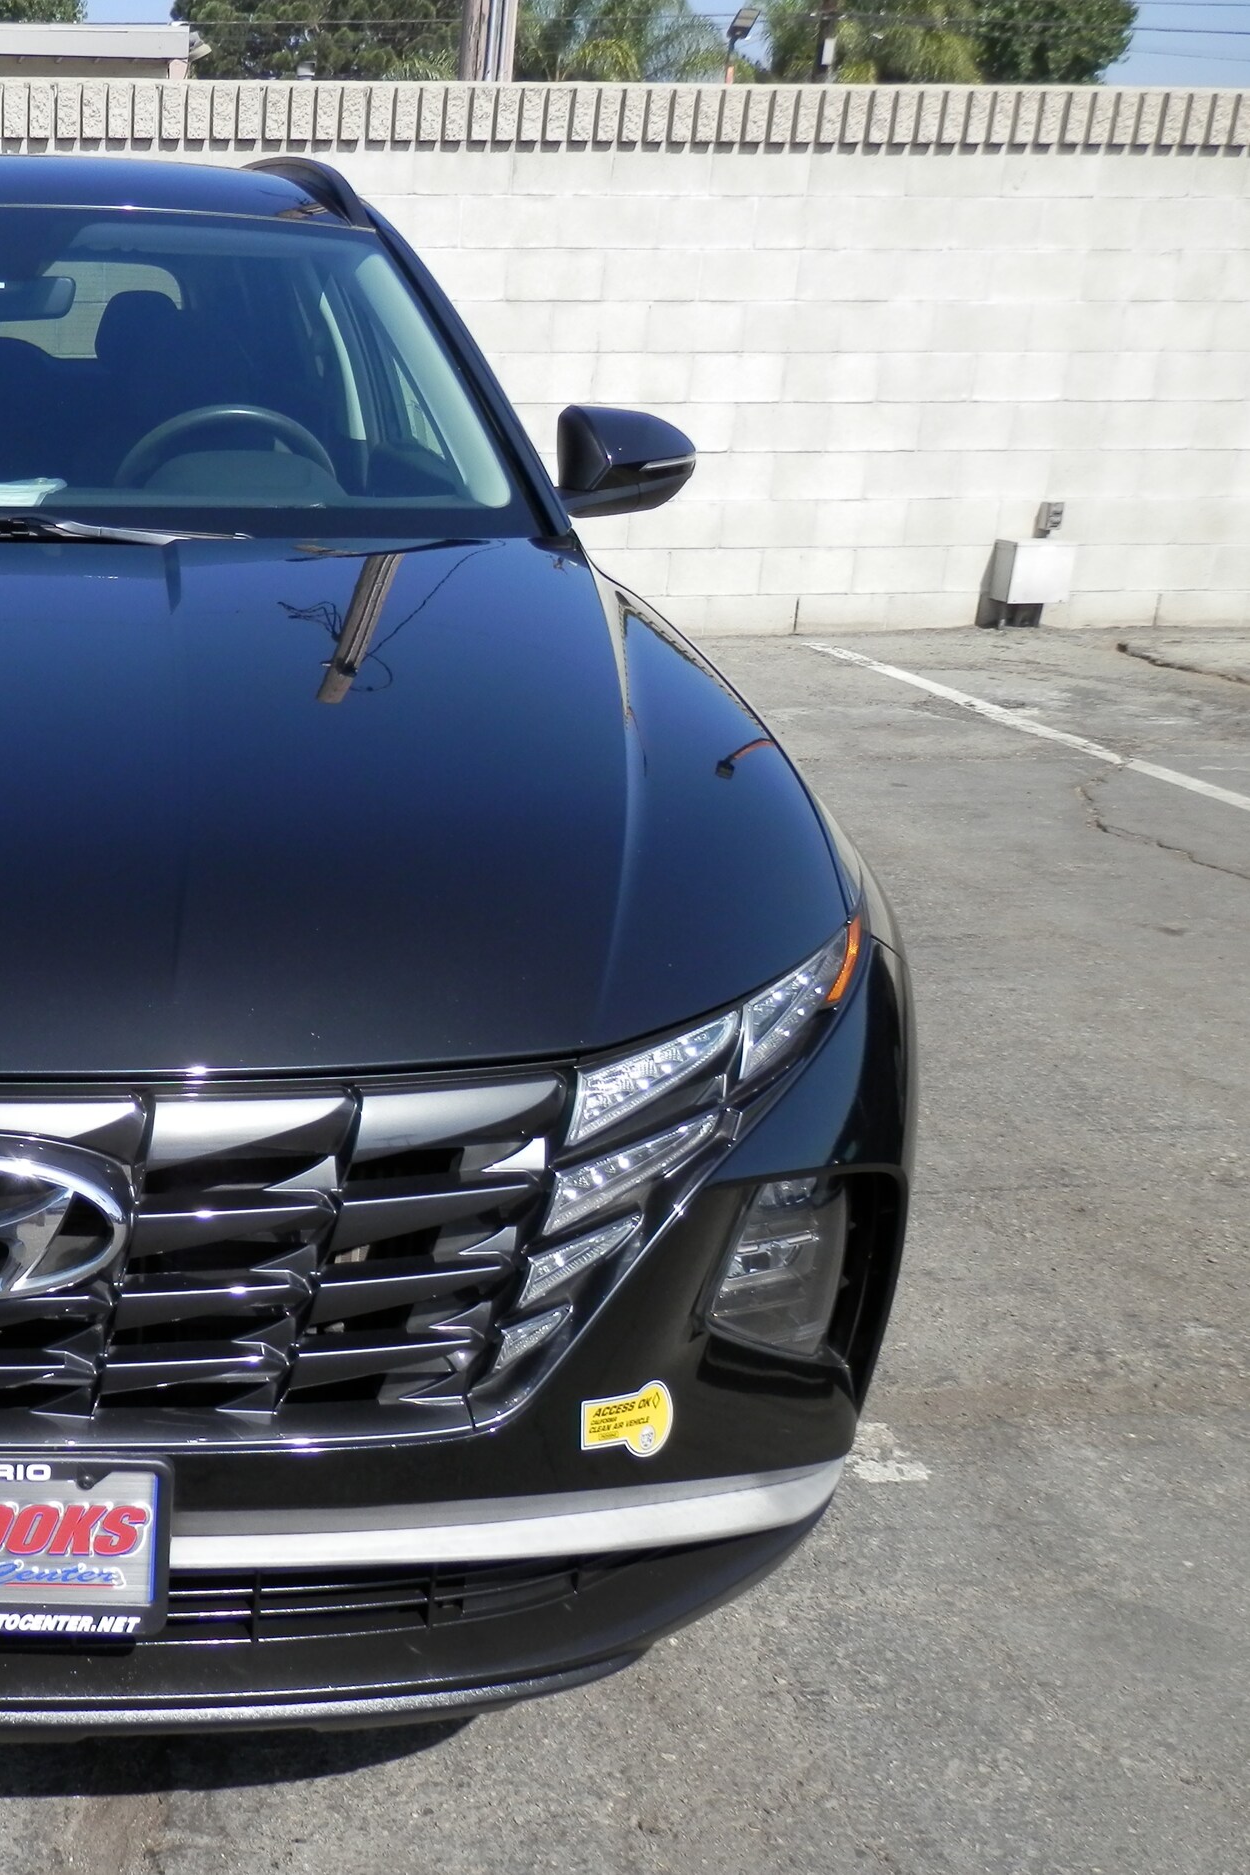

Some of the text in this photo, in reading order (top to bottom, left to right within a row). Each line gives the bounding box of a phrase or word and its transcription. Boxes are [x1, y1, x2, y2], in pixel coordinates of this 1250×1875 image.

[593, 1397, 653, 1418] ACCESS OK
[589, 1423, 612, 1434] CLEAN
[626, 1416, 650, 1427] VEHICLE
